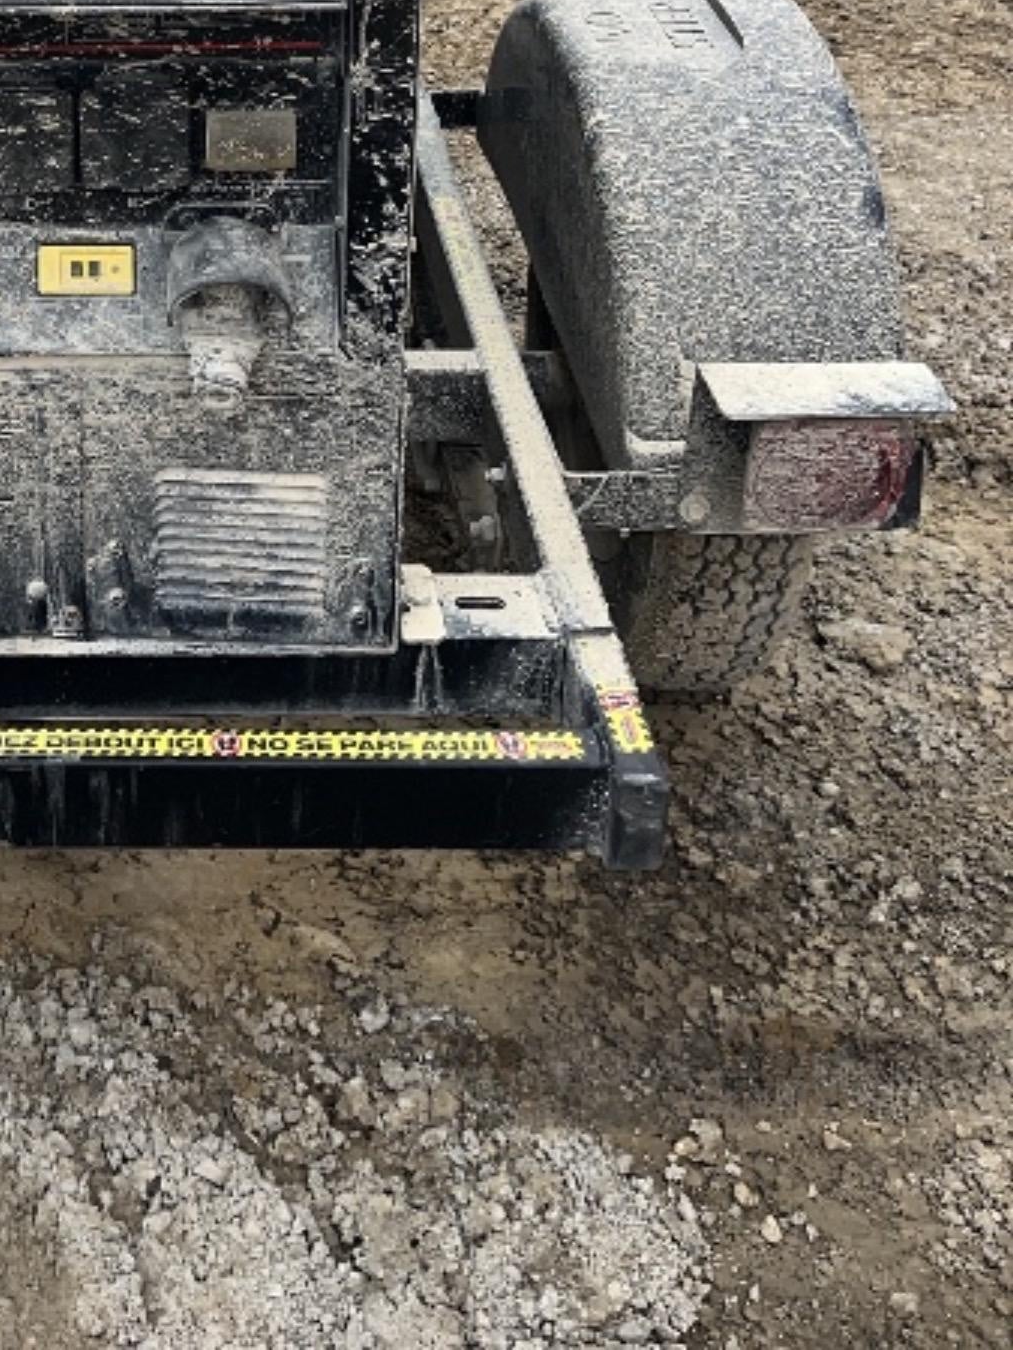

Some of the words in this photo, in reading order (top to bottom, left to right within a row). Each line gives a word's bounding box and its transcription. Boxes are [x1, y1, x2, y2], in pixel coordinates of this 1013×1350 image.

[46, 735, 162, 748] DEBOUT
[247, 737, 288, 751] NO
[295, 737, 333, 751] SE
